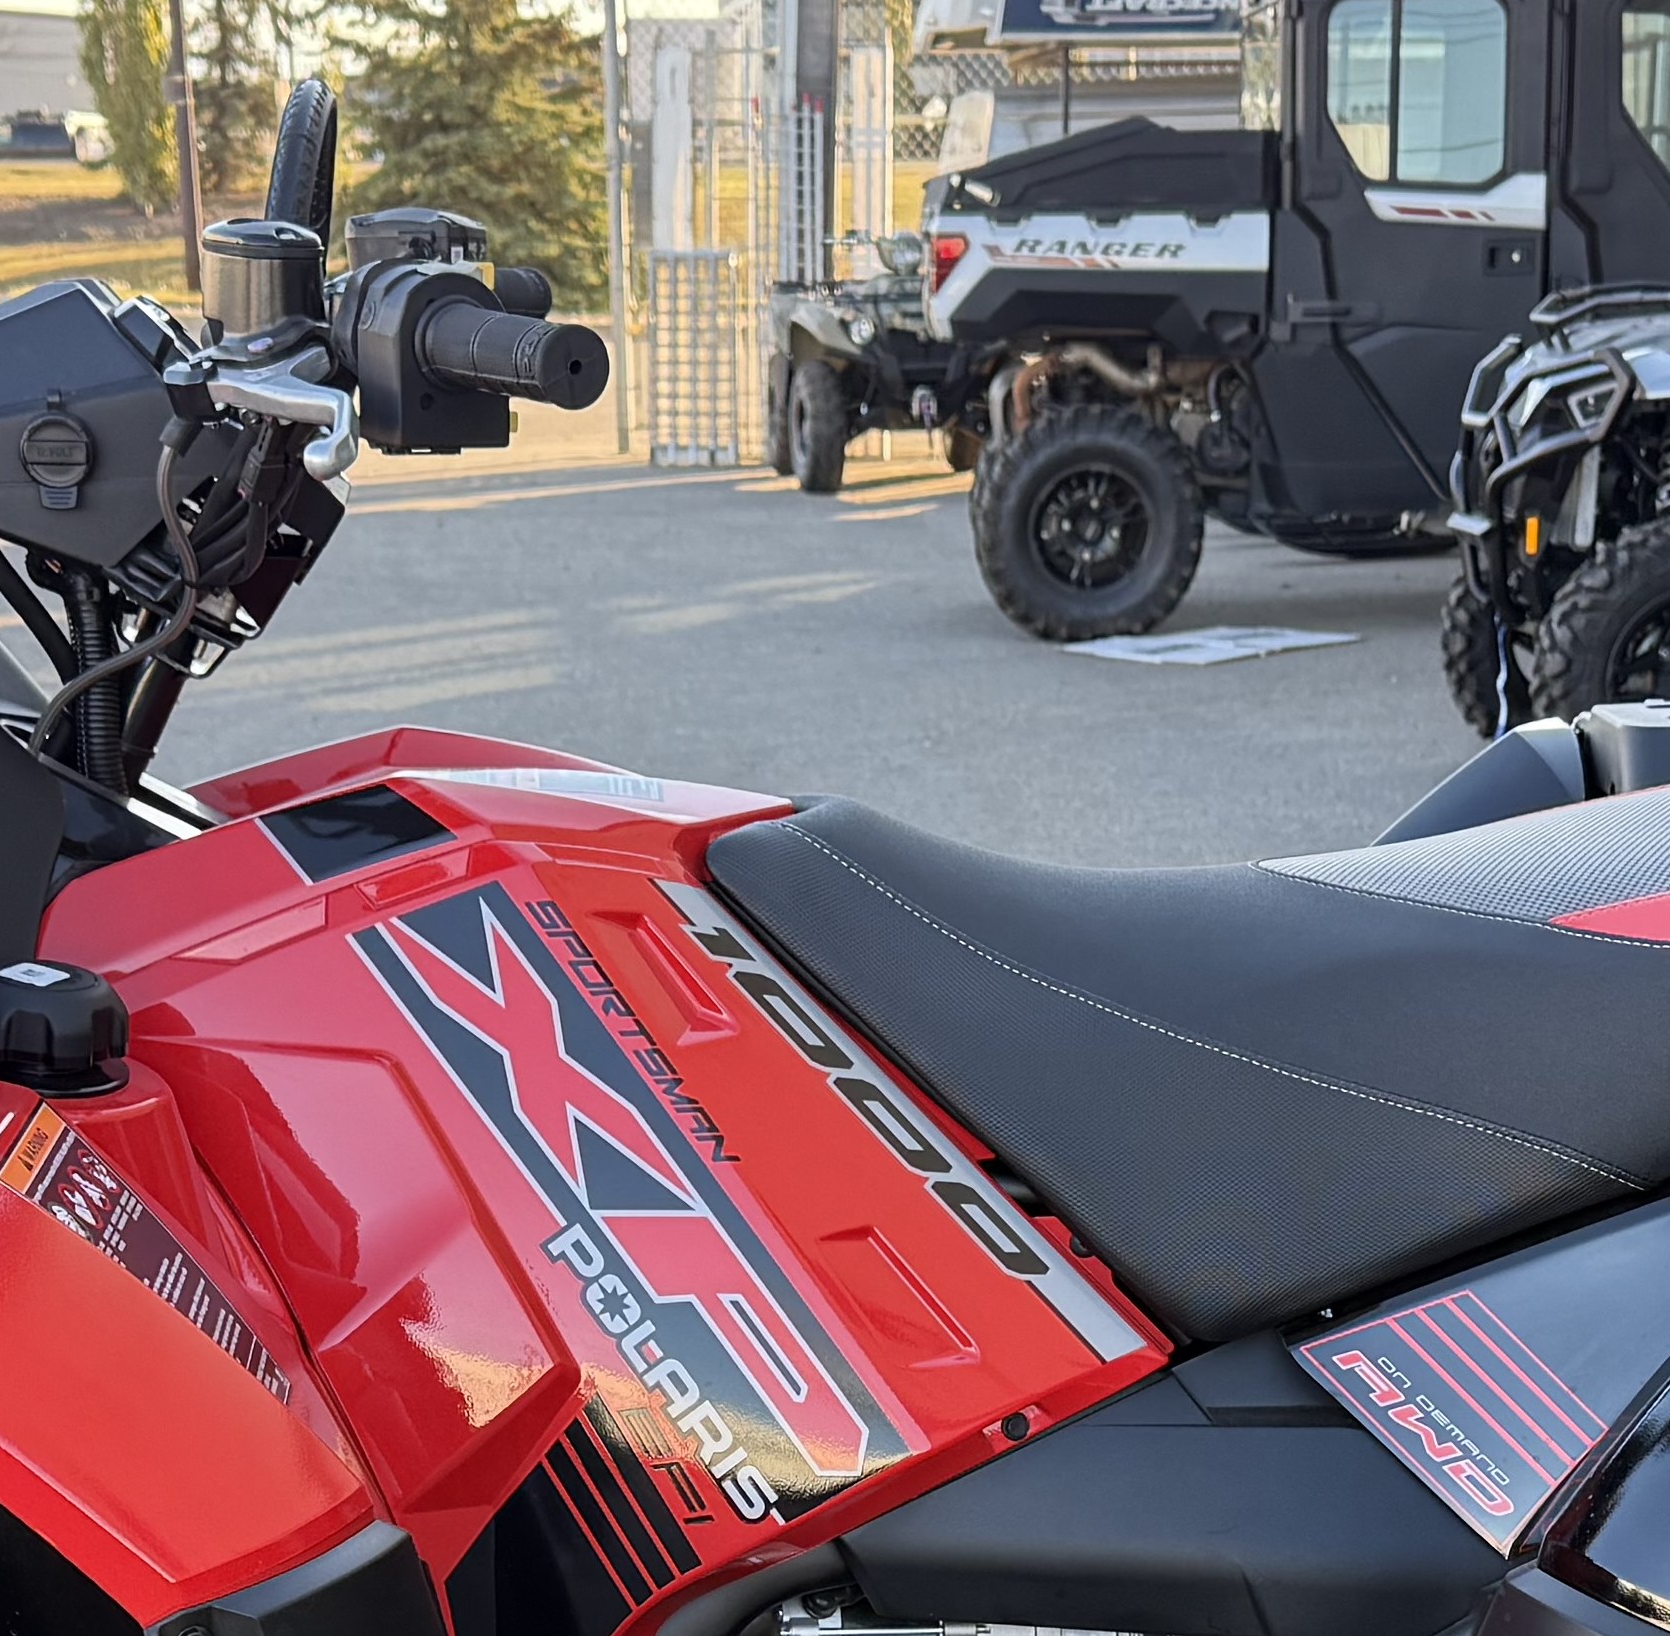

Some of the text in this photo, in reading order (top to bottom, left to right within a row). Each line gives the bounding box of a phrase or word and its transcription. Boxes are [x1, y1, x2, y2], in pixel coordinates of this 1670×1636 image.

[1013, 238, 1186, 259] RANGER
[525, 899, 741, 1165] SPORTSMAN
[685, 922, 1051, 1280] 1000
[389, 894, 873, 1478] XP
[548, 1223, 779, 1524] POLARIS
[618, 1405, 715, 1527] EFI
[1331, 1349, 1515, 1517] AWD
[1377, 1355, 1510, 1487] ON DEMAND
